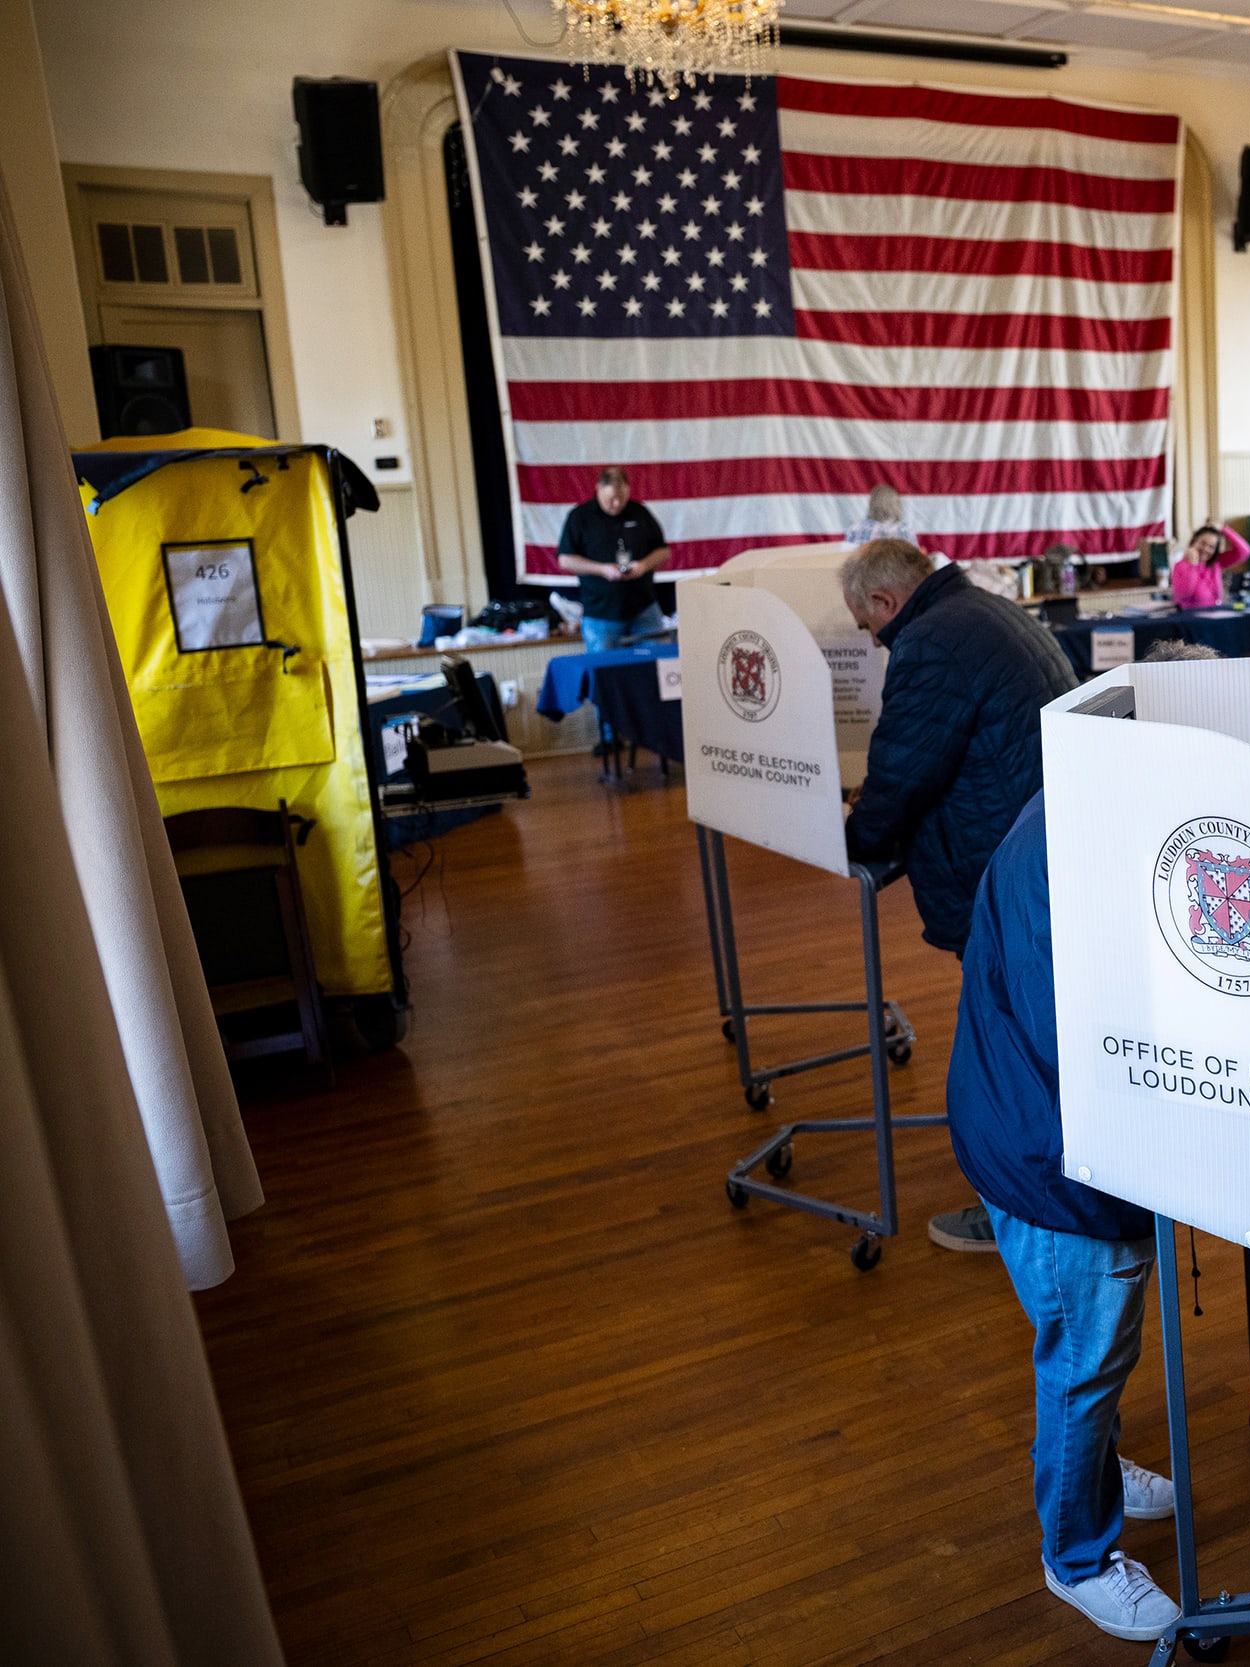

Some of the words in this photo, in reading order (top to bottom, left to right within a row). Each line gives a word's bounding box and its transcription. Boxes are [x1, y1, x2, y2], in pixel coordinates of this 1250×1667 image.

[195, 563, 229, 579] 426
[701, 745, 737, 761] OFFICE
[741, 752, 754, 763] OF
[759, 754, 821, 775] ELECTIONS
[712, 760, 762, 779] LOUDOUN
[766, 770, 811, 787] COUNTY
[1158, 826, 1196, 882] LOUDOUN
[1217, 976, 1250, 992] 1757
[1103, 1036, 1194, 1070] OFFICE
[1205, 1055, 1238, 1077] OF
